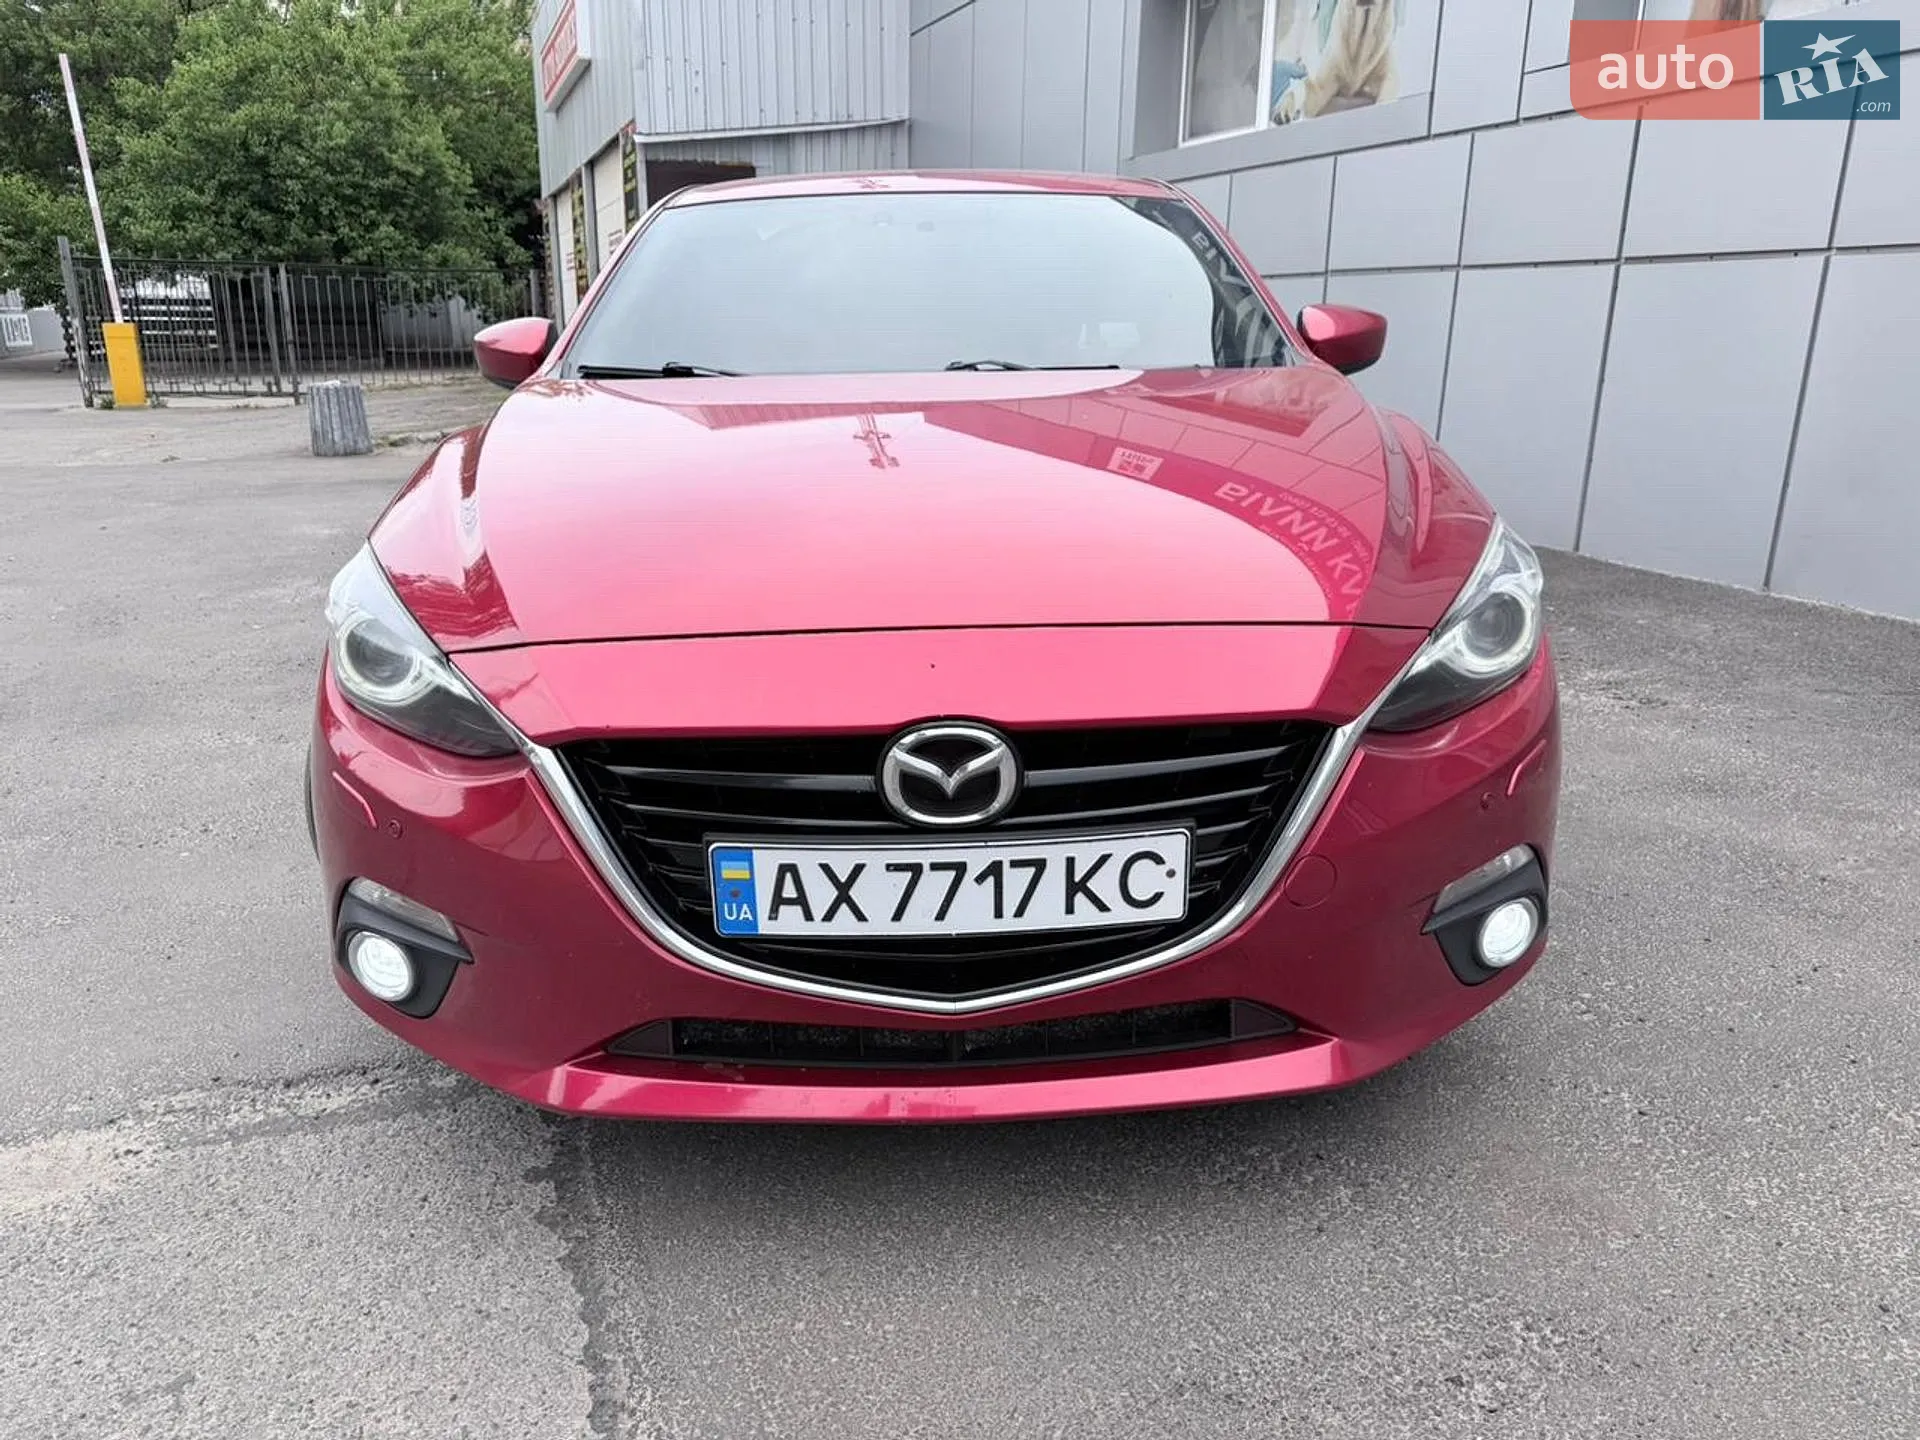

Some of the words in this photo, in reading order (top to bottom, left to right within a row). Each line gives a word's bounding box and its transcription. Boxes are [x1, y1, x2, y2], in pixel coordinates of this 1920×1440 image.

[768, 862, 869, 923] AX
[884, 857, 1048, 923] 7717
[1064, 849, 1168, 916] KC
[723, 903, 754, 922] UA
